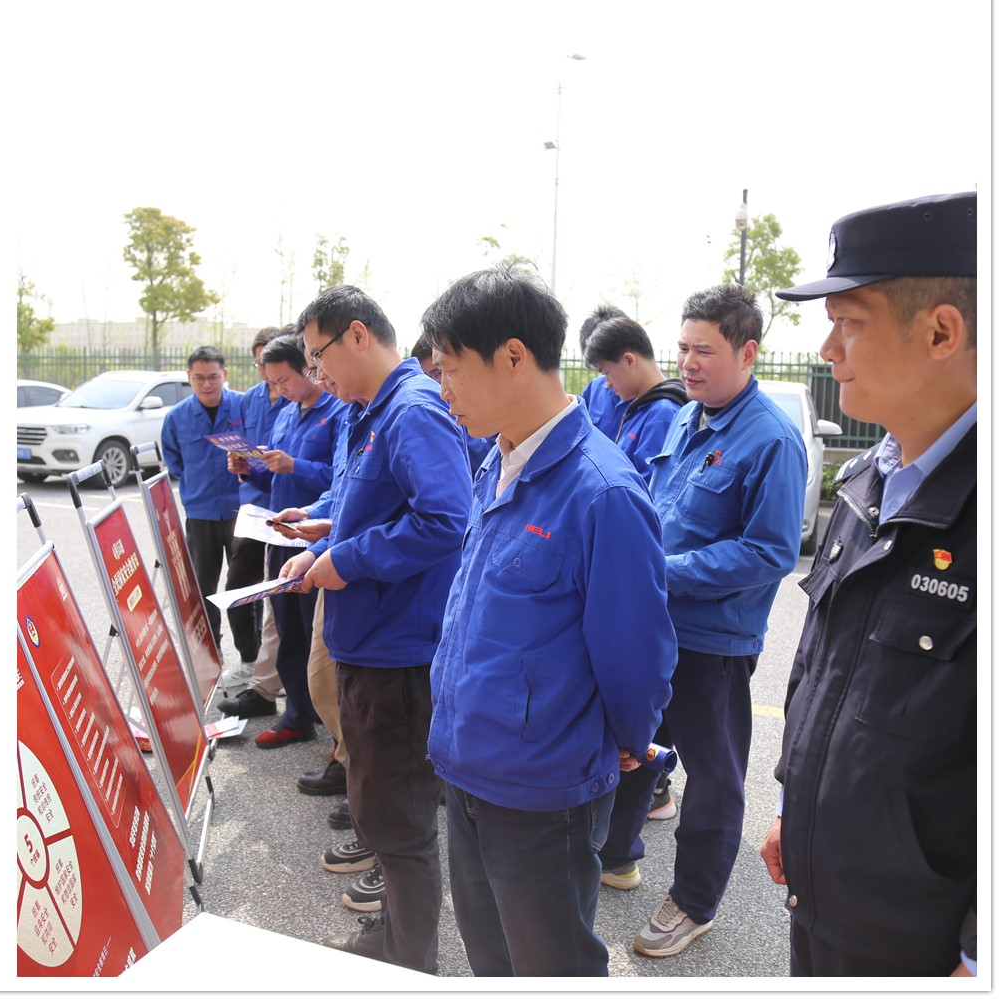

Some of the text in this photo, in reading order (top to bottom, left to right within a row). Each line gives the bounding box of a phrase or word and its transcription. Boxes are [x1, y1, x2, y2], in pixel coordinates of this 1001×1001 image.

[524, 523, 553, 540] HELI
[910, 573, 969, 603] 030605
[23, 833, 33, 849] 5
